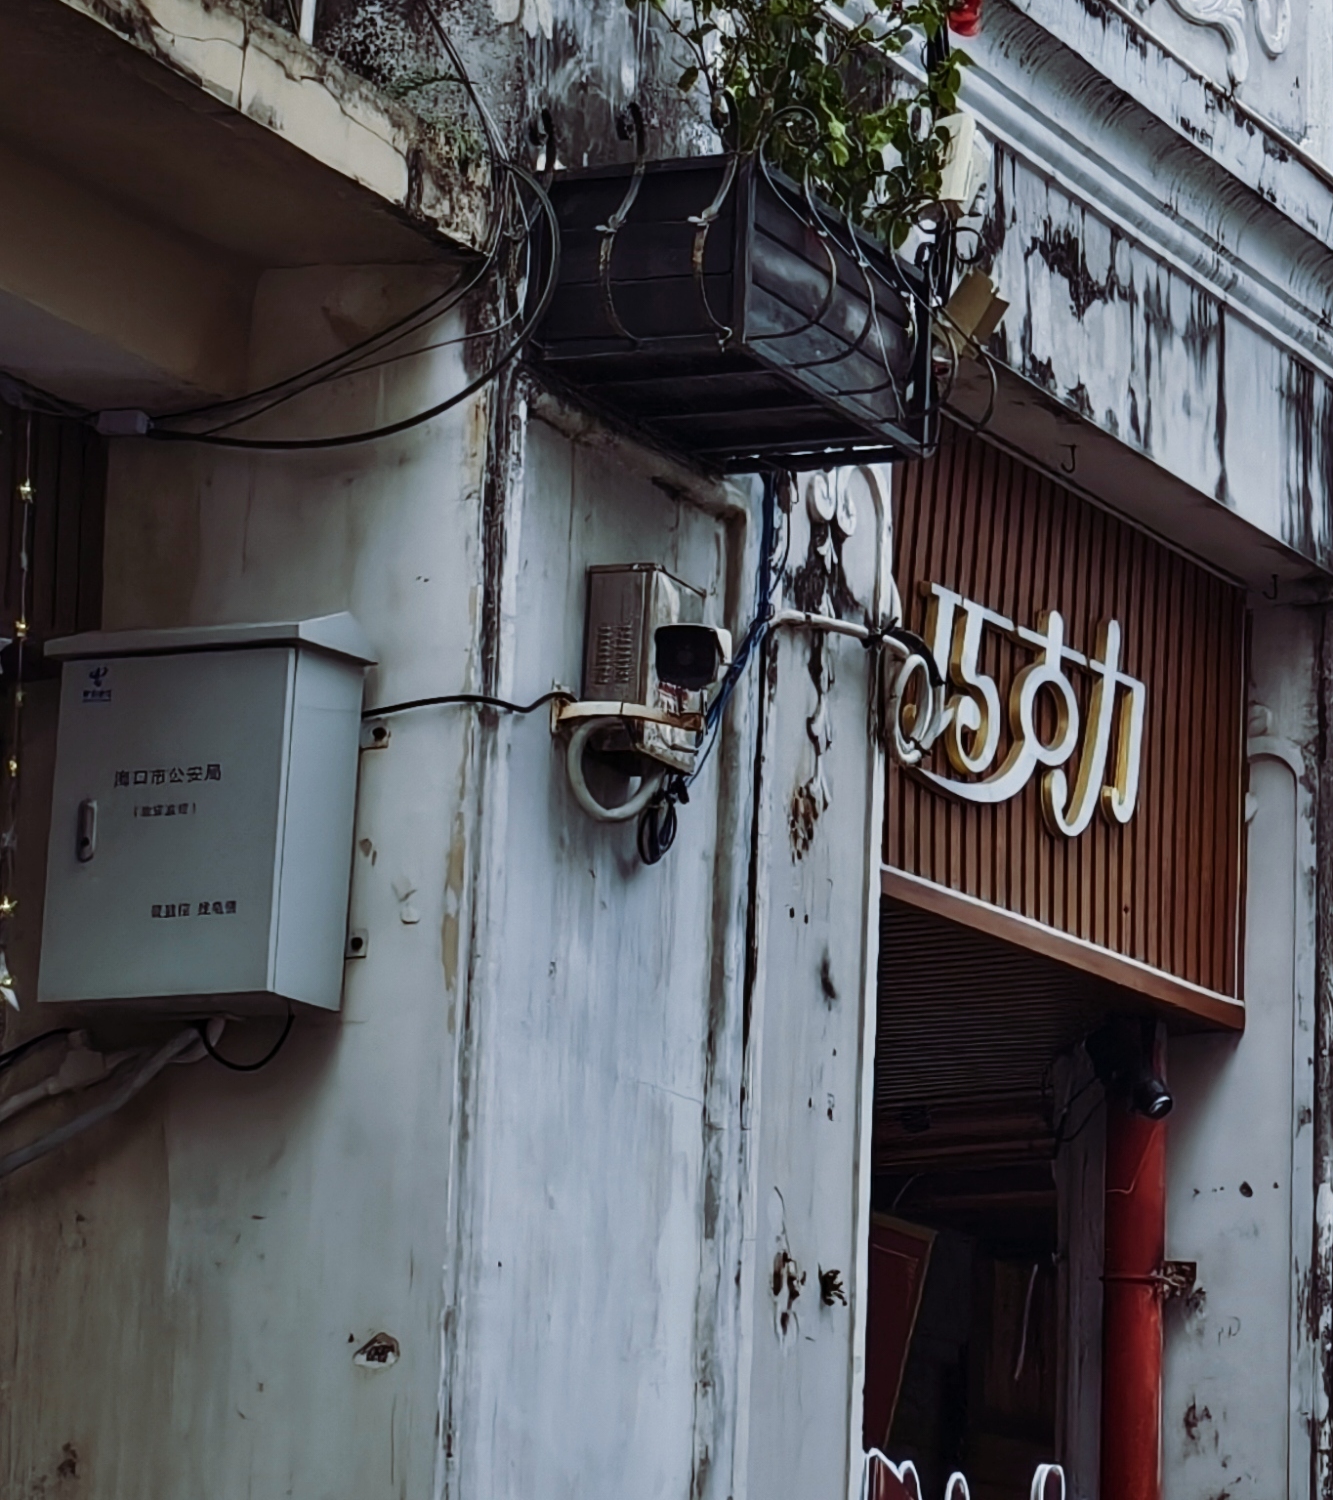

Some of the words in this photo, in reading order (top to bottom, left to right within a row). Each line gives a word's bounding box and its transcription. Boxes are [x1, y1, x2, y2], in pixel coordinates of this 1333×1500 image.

[113, 763, 222, 788] 海口市公安局
